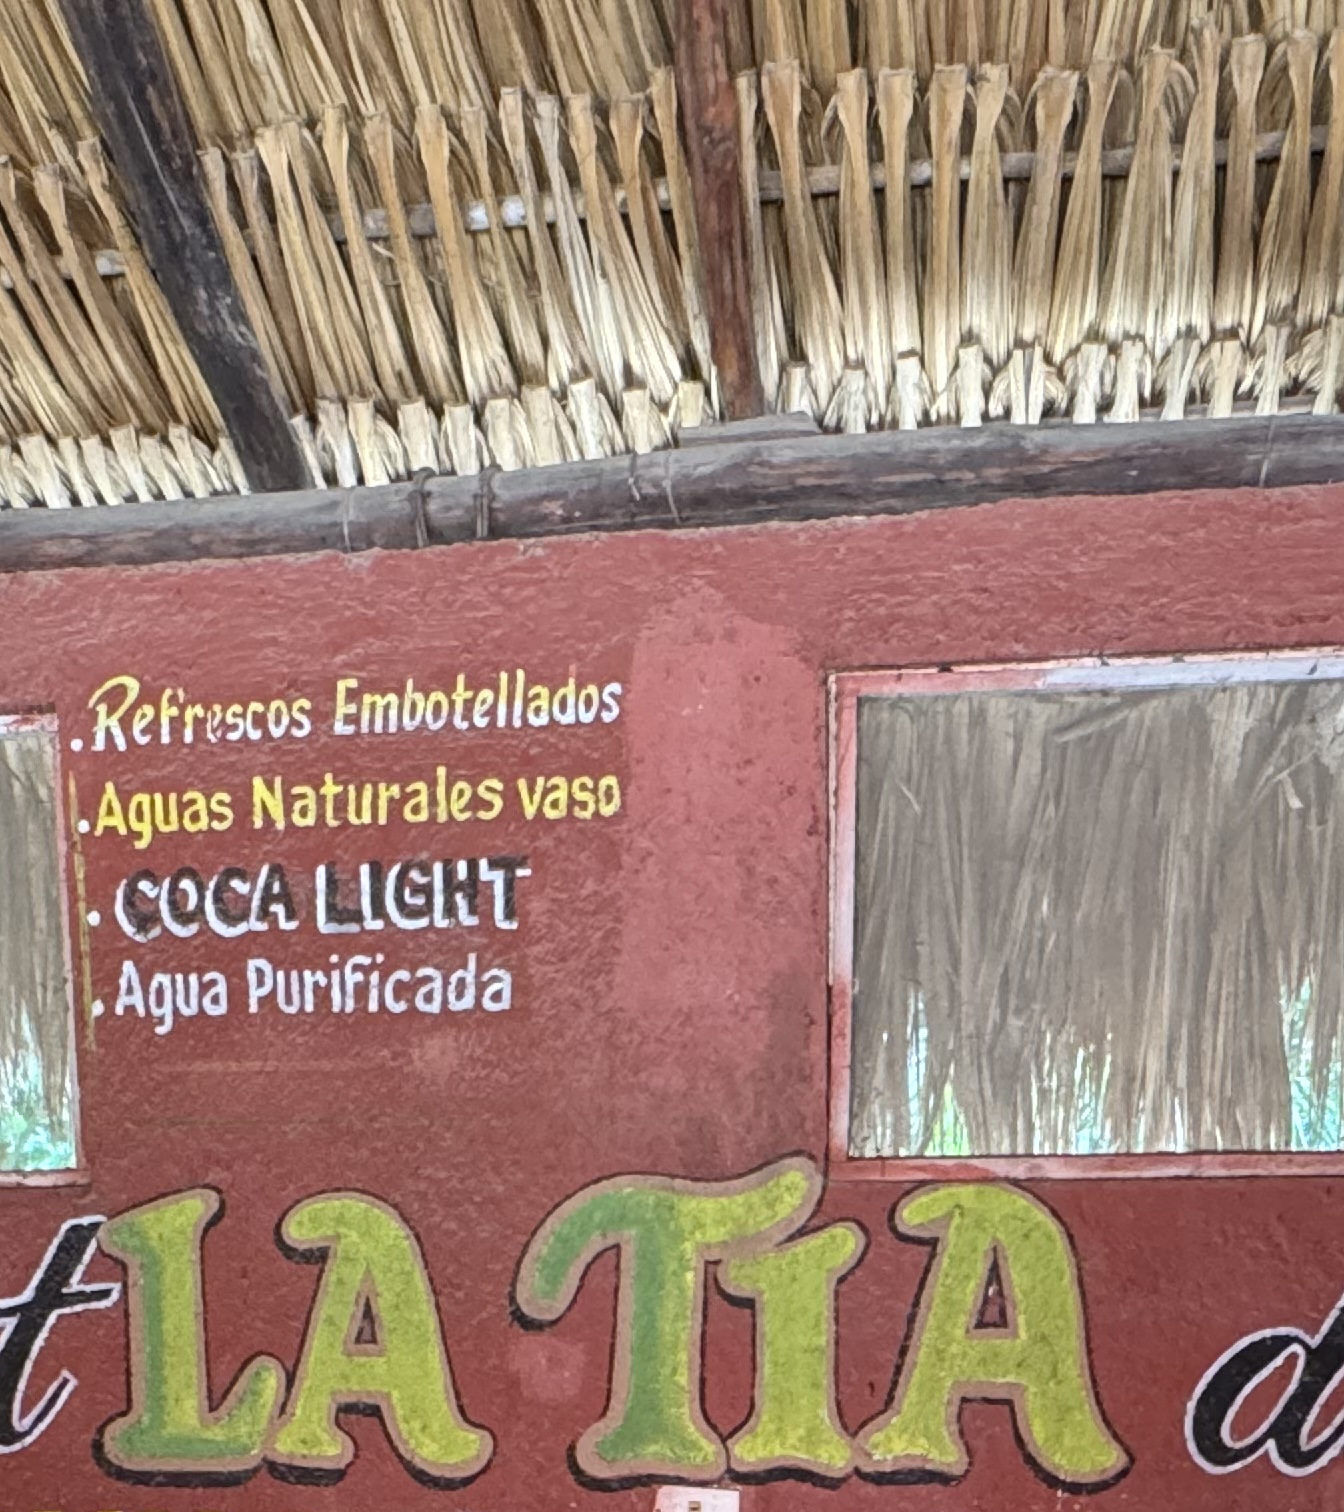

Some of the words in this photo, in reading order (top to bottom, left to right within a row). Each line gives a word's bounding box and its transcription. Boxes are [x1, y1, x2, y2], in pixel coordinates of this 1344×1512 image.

[334, 667, 623, 736] Embotellados
[94, 782, 235, 849] Aguas
[252, 766, 505, 830] Naturales
[518, 773, 622, 821] vaso
[114, 862, 299, 943] COCA
[315, 853, 532, 934] LIGHT
[114, 960, 228, 1035] Agua
[246, 952, 513, 1015] Purificada
[92, 1184, 496, 1489] LA
